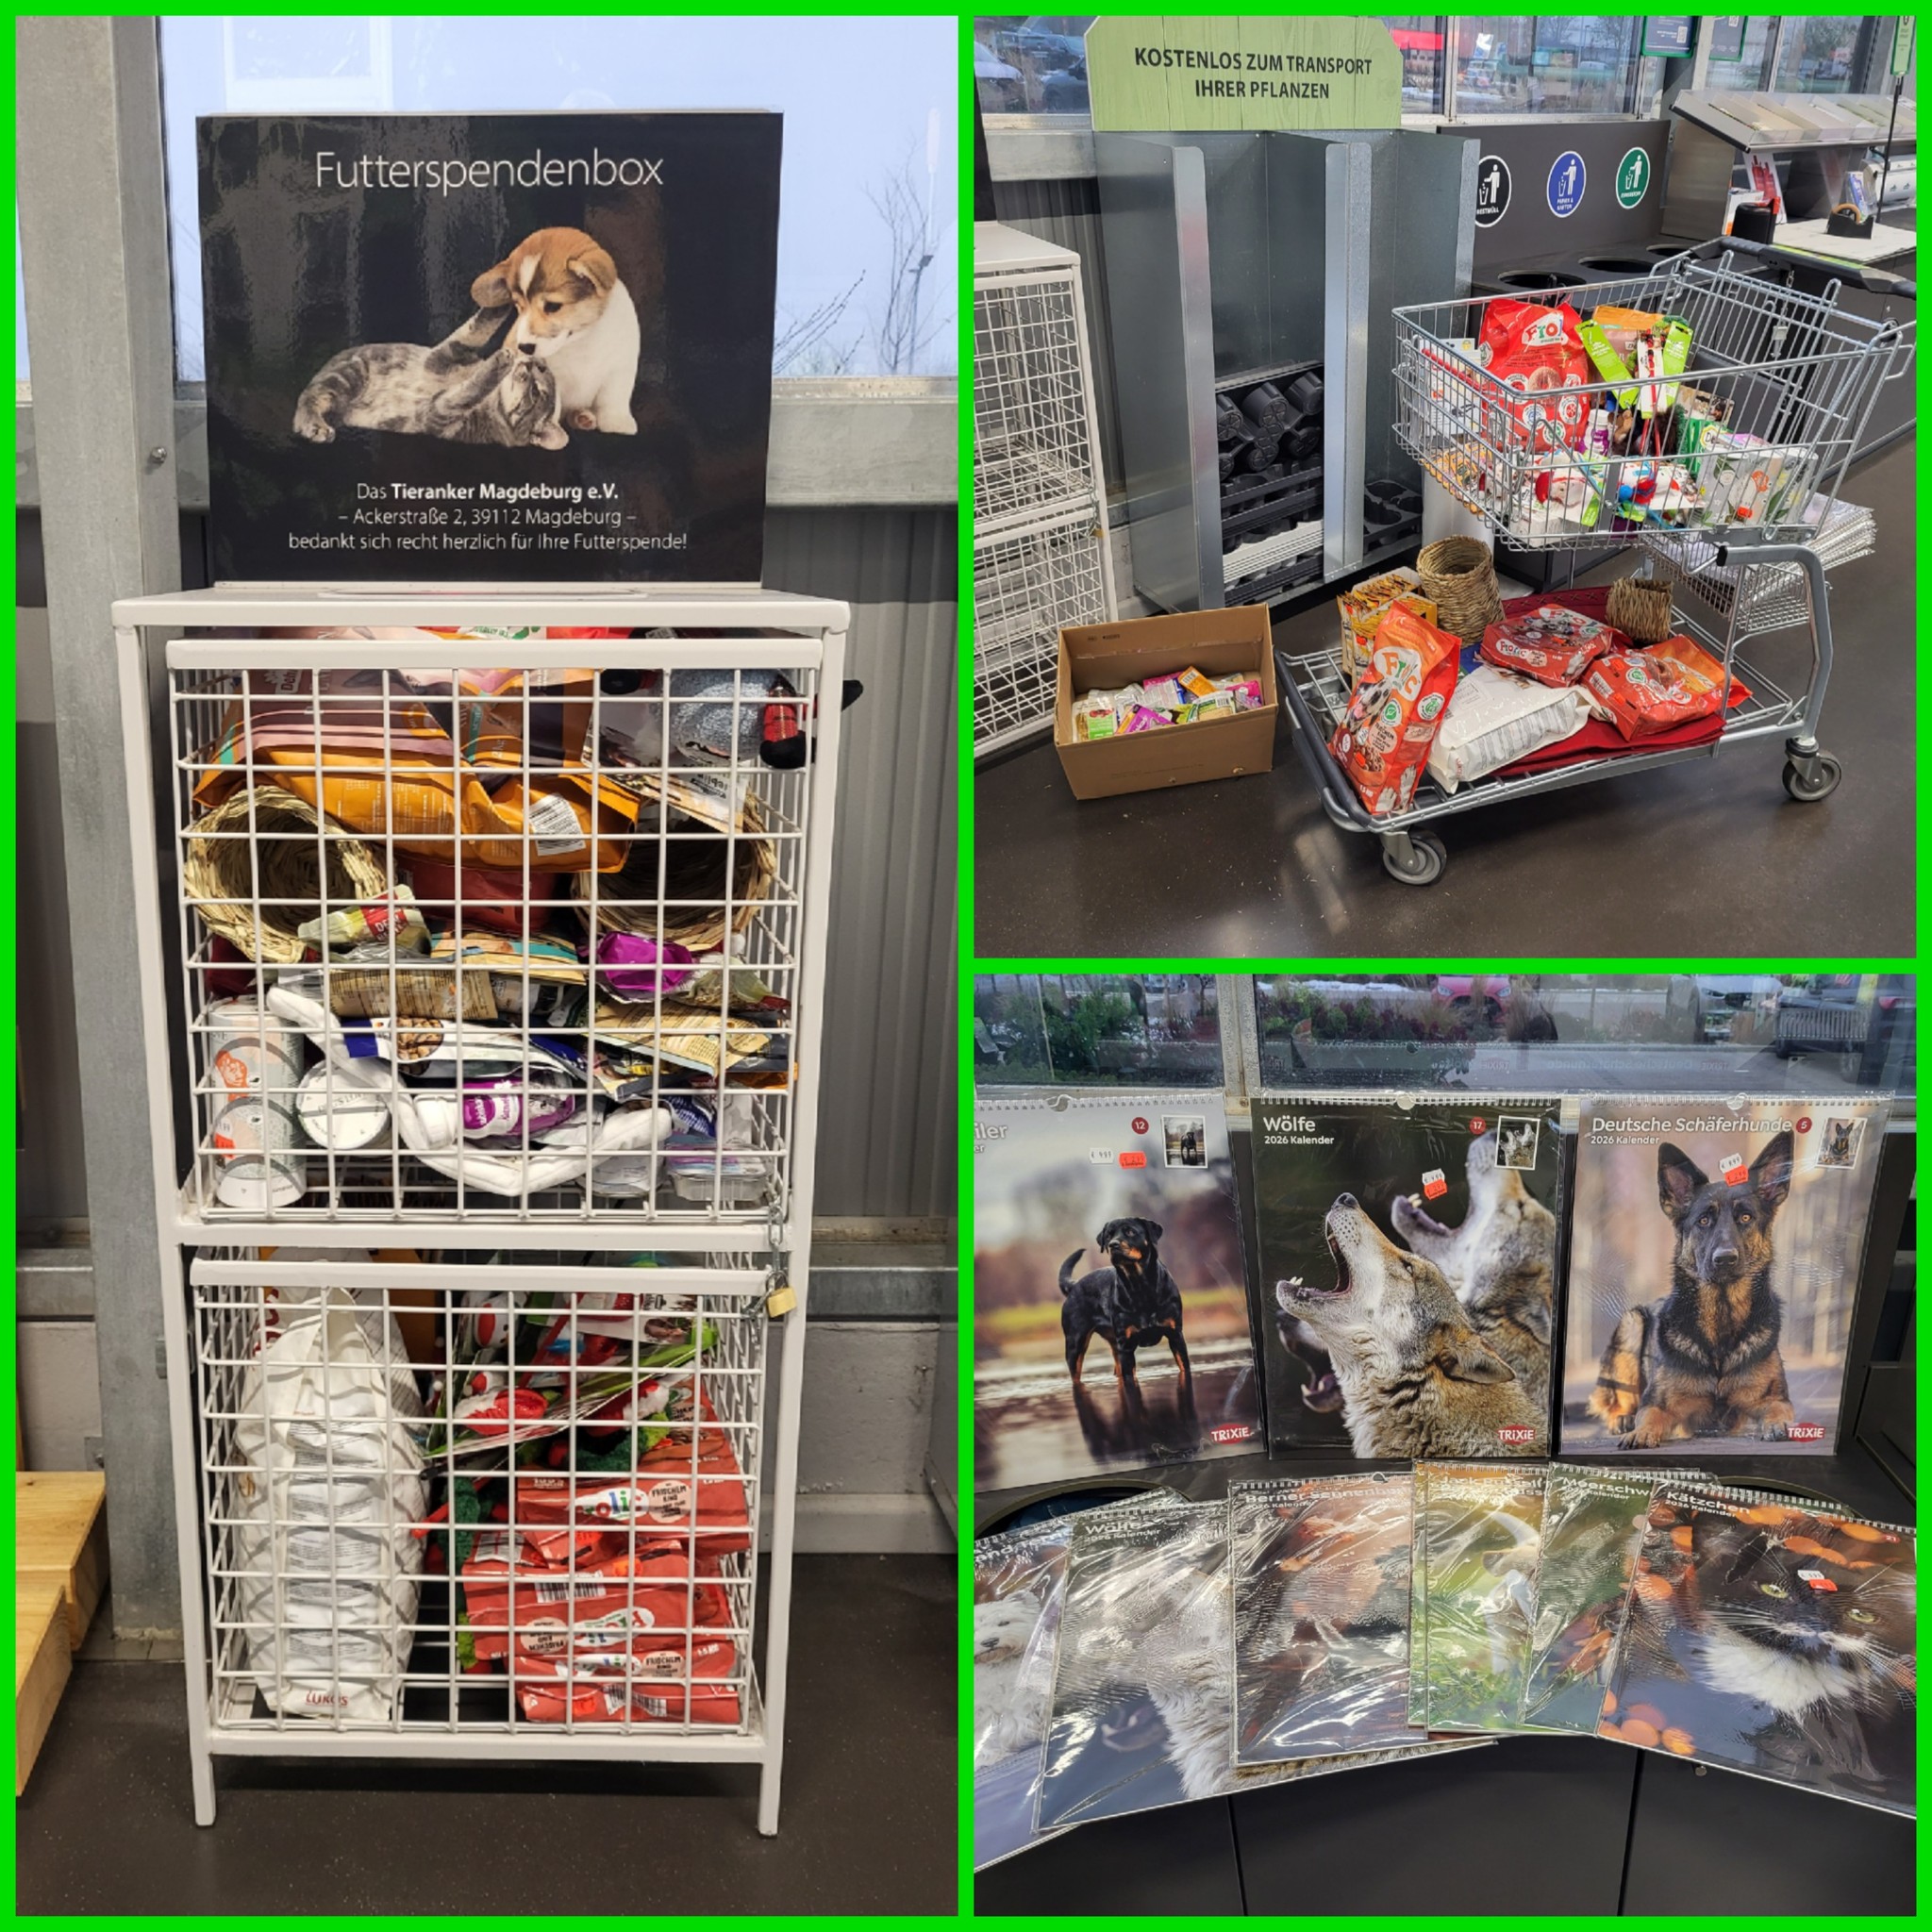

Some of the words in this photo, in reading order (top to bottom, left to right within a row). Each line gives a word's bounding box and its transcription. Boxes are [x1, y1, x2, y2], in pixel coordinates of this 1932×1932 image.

[1134, 47, 1241, 70] KOSTENLOS
[1246, 53, 1283, 72] ZUM
[1286, 55, 1373, 75] TRANSPORT
[1195, 79, 1246, 97] IHRER
[1250, 81, 1329, 99] PFLANZEN
[315, 148, 664, 195] Futterspendenbox
[357, 483, 387, 499] Das
[391, 483, 475, 499] Tieranker
[479, 483, 583, 504] Magdeburg
[587, 483, 619, 499] e.V.
[353, 508, 448, 525] Ackerstraße
[453, 508, 467, 526] 2,
[472, 508, 521, 525] 39112
[525, 508, 622, 528] Magdeburg
[289, 532, 356, 549] bedankt
[360, 533, 391, 549] sich
[397, 533, 439, 550] recht
[442, 532, 507, 550] herzlich
[510, 532, 533, 550] für
[538, 533, 570, 550] Ihre
[574, 532, 688, 553] Futterspende!
[1134, 1121, 1146, 1130] 12
[1262, 1116, 1316, 1132] Wölfe
[1473, 1121, 1482, 1129] 17
[1591, 1116, 1673, 1132] Deutsche
[1674, 1116, 1792, 1132] Schäferhunde
[1801, 1121, 1807, 1129] 5
[1264, 1135, 1289, 1144] 2026
[1291, 1135, 1335, 1144] Kalender
[1591, 1135, 1614, 1144] 2026
[1616, 1135, 1659, 1144] Kalender
[1562, 1476, 1651, 1497] Meerschw
[1667, 1491, 1751, 1515] Kätzchen
